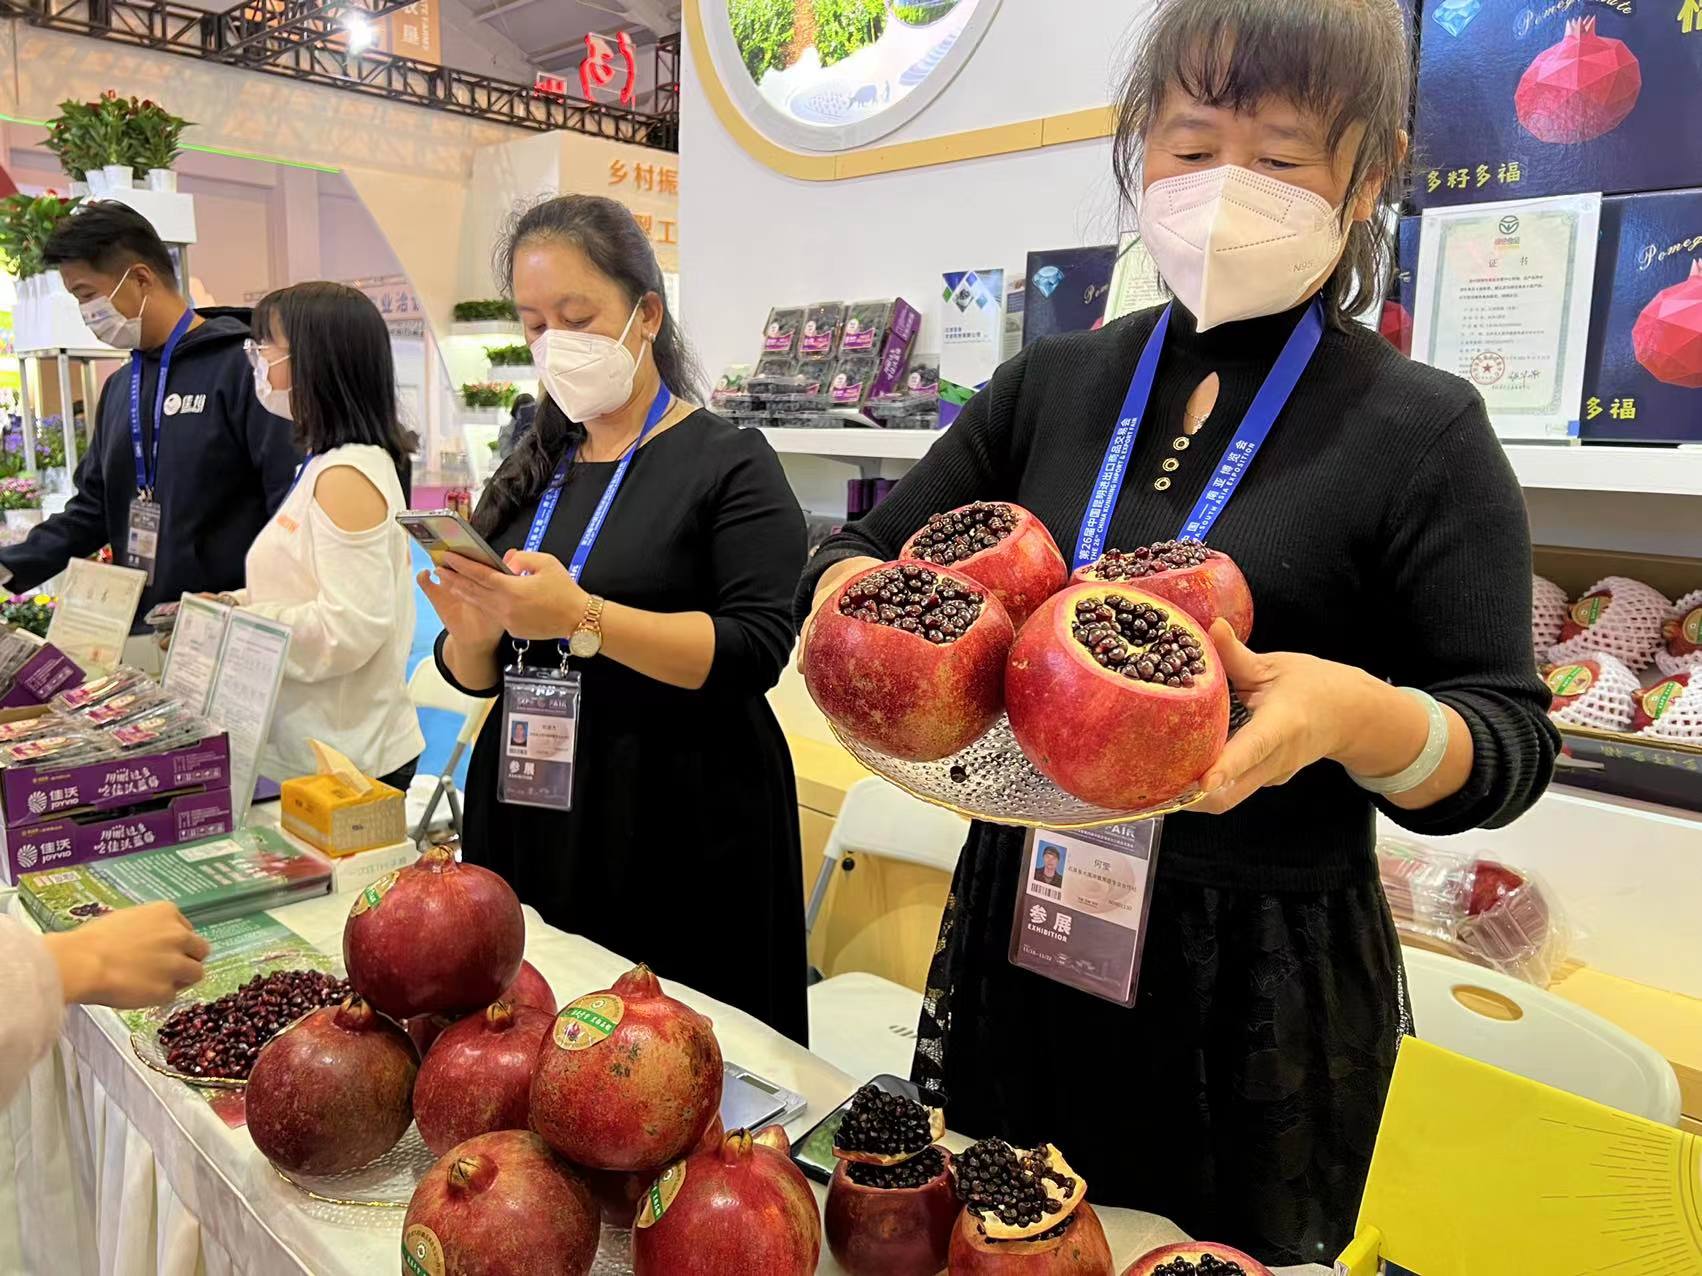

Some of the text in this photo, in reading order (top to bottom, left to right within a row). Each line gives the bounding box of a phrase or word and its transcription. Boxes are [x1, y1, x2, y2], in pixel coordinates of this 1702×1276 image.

[608, 160, 678, 196] 乡村振
[1427, 162, 1522, 192] 多籽多福
[1586, 396, 1637, 420] 多福
[1096, 513, 1107, 533] CHINA
[1103, 483, 1116, 512] KUNMING
[1113, 460, 1124, 483] IMPORT
[1122, 430, 1133, 454] EXPORT
[1214, 486, 1229, 505] ASIA
[1228, 442, 1255, 486] EXPOSITION
[50, 786, 79, 801] 佳沃
[40, 838, 72, 855] 佳沃
[1027, 923, 1068, 943] EXHIBITION
[1029, 904, 1072, 935] 参展
